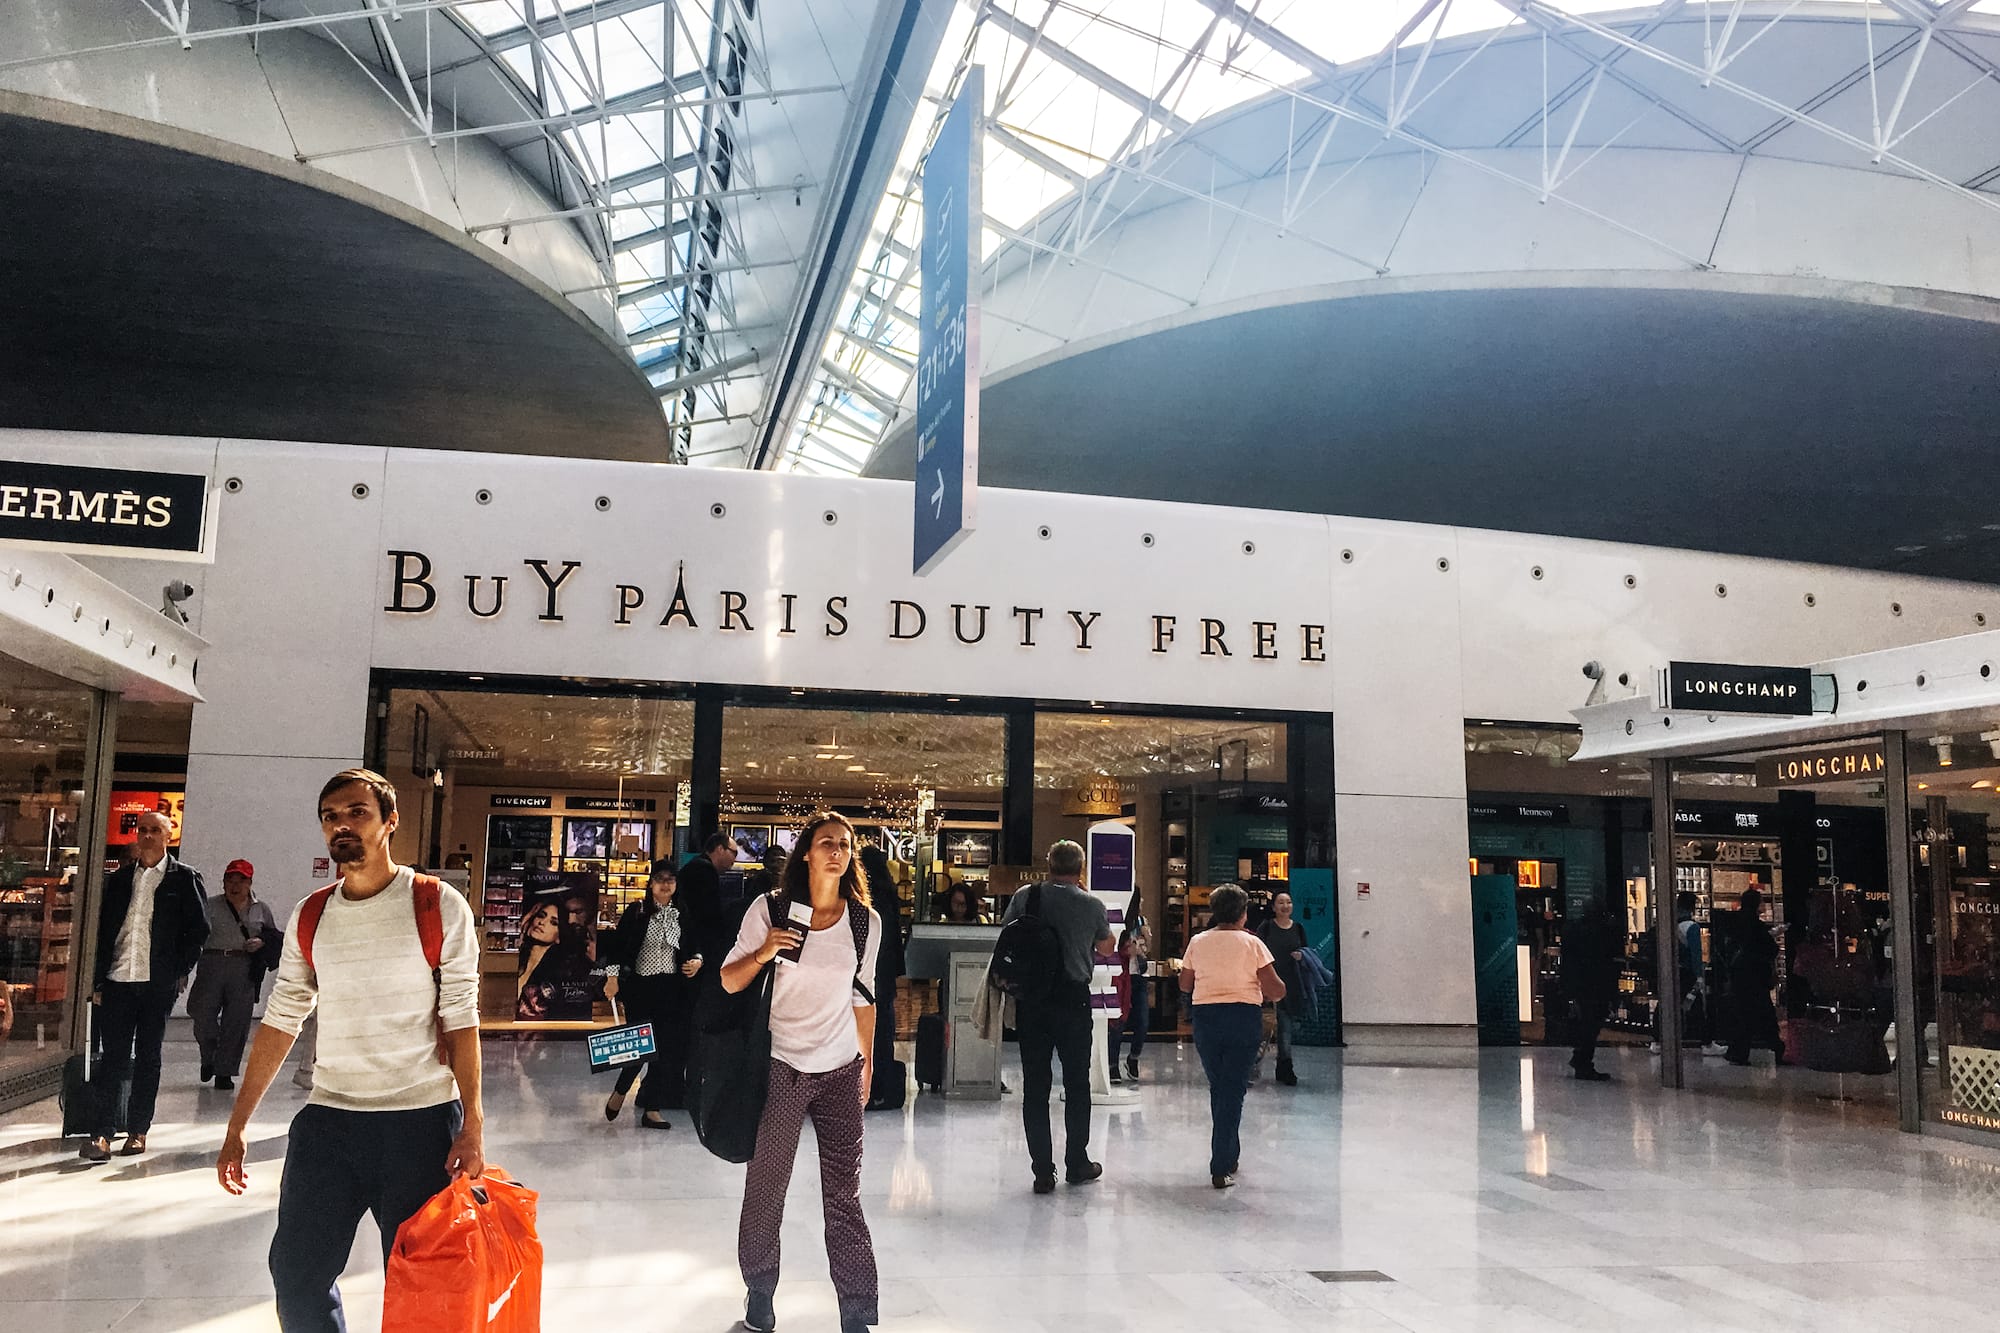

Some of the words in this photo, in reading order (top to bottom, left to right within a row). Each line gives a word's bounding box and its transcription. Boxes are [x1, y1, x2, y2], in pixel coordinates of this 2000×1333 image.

[918, 344, 938, 409] F21
[943, 303, 965, 375] F36
[0, 485, 172, 528] ERMÈS
[383, 550, 581, 622] BUY
[614, 560, 848, 637] PARIS
[889, 599, 1101, 649] DUTY
[1151, 615, 1327, 662] FREE
[1685, 680, 1797, 698] LONGCHAMP
[495, 797, 547, 807] GIVENCHY
[1078, 787, 1119, 803] GOLD
[1518, 807, 1554, 818] Hennessy
[1735, 812, 1760, 828] 烟草
[1815, 818, 1831, 828] CO
